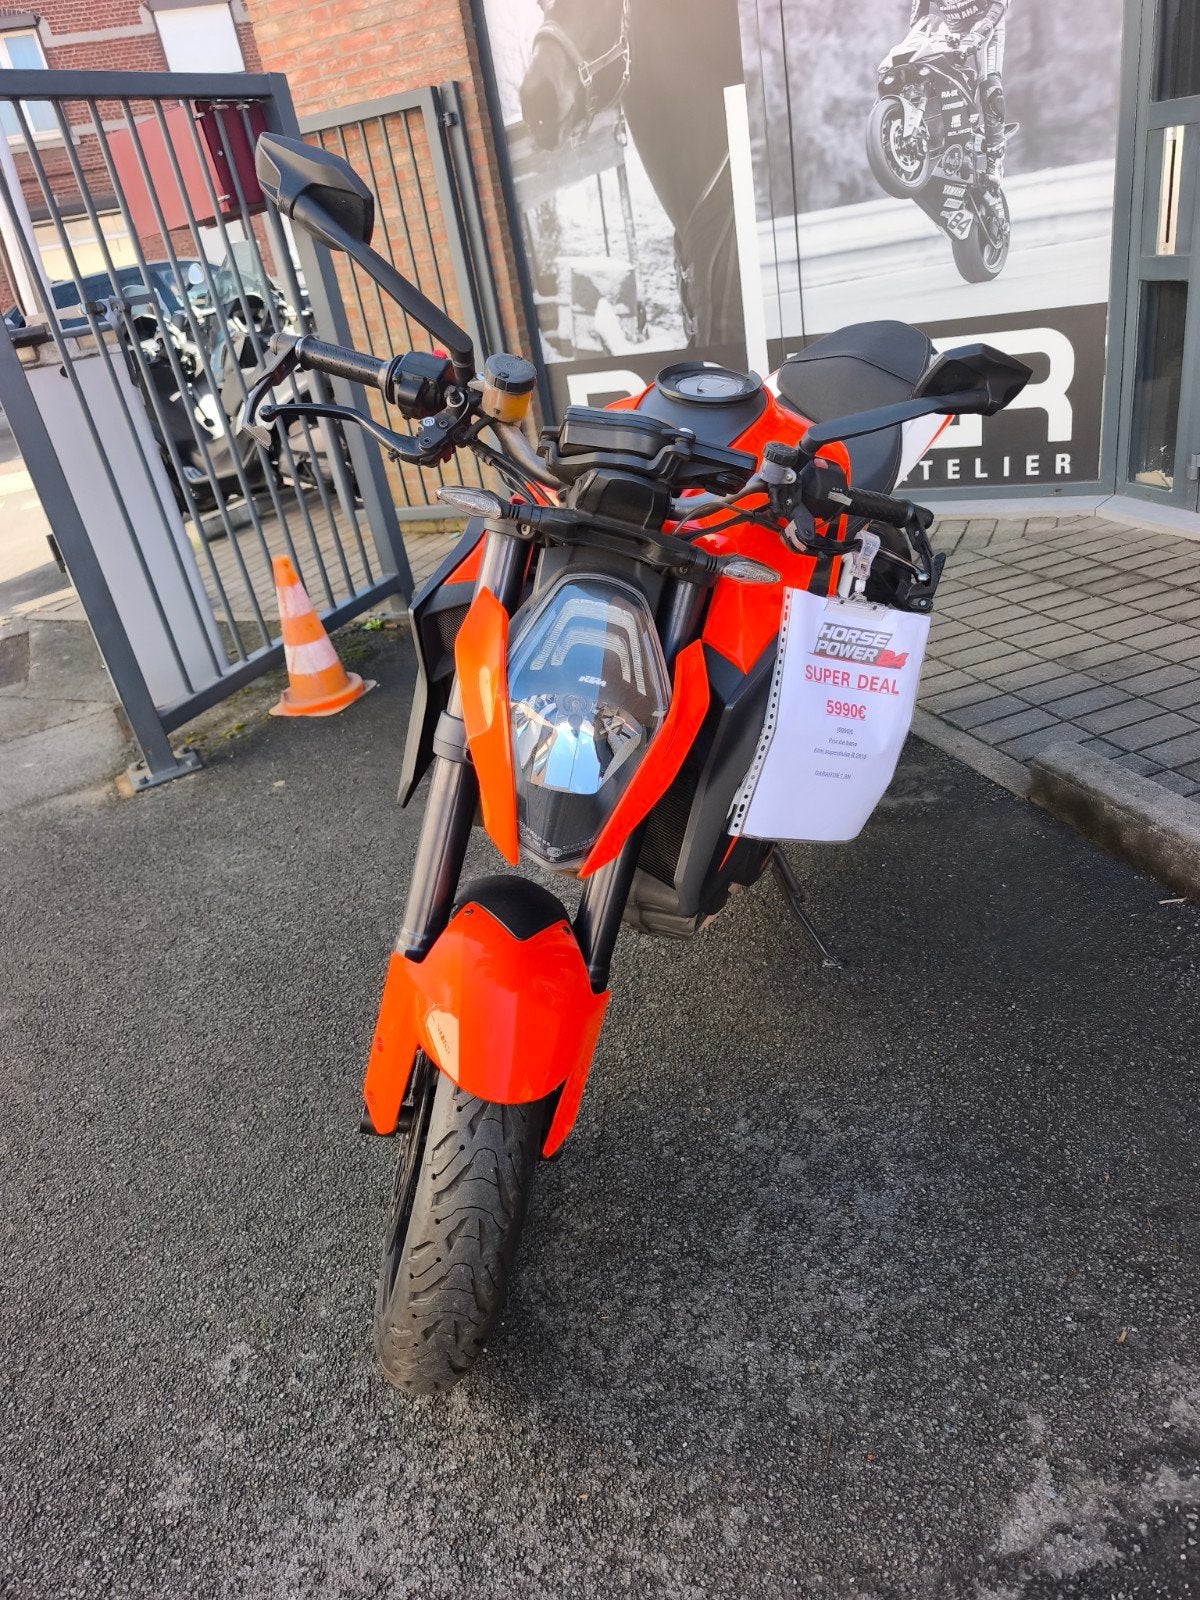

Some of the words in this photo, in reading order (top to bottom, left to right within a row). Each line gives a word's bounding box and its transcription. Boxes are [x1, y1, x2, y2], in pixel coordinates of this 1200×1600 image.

[901, 453, 1072, 482] TELIER
[818, 624, 892, 648] HORSE
[815, 639, 879, 662] POWER
[804, 664, 851, 687] SUPER
[857, 674, 900, 696] DEAL
[826, 699, 867, 719] 5990€
